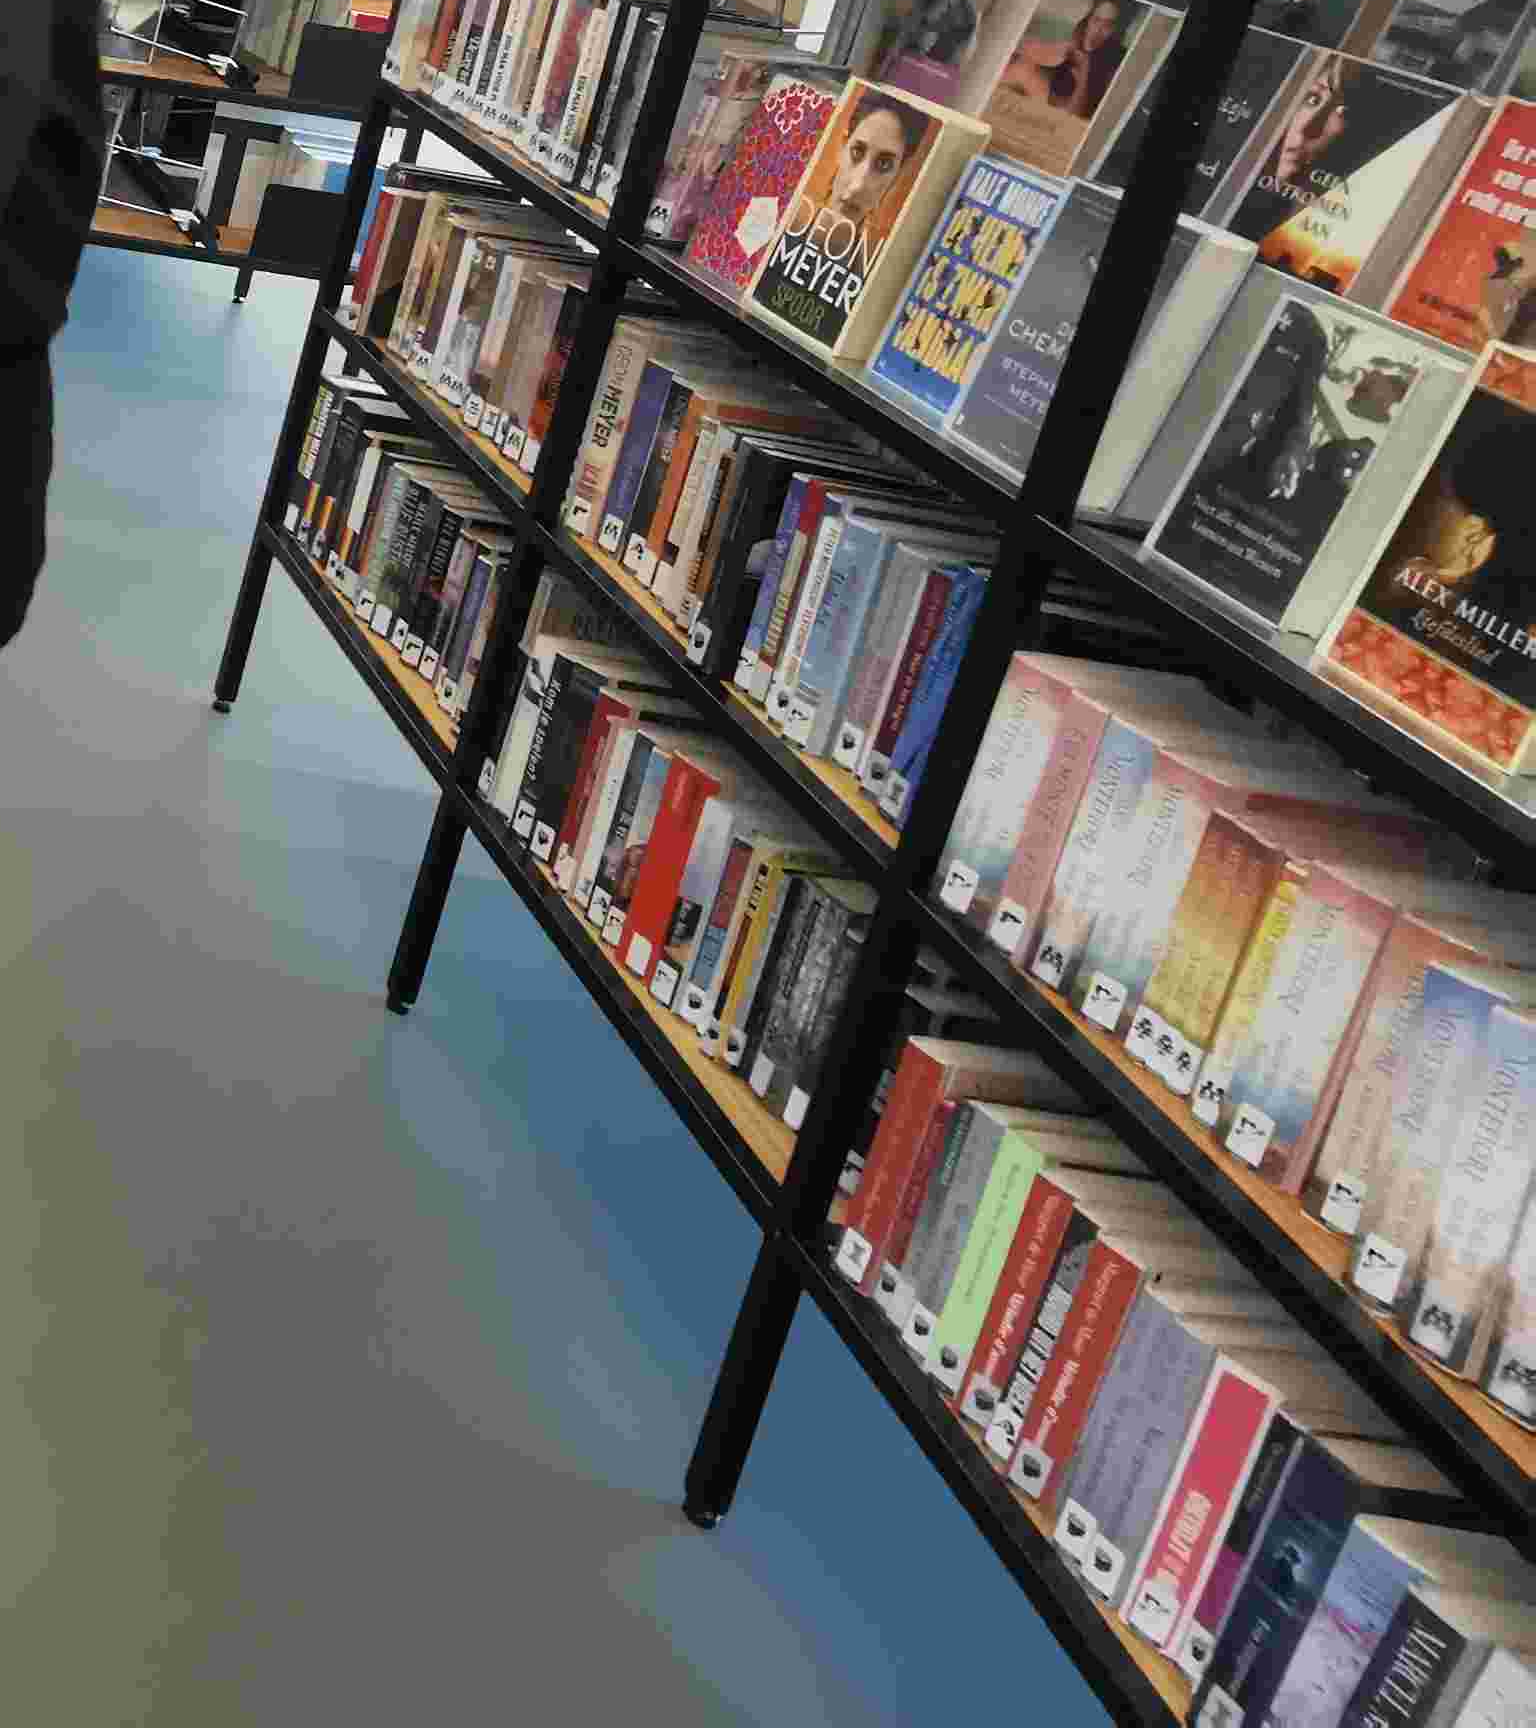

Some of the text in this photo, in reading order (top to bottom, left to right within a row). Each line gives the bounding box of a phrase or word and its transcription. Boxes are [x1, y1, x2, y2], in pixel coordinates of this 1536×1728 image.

[784, 196, 888, 276] DEON
[769, 237, 866, 313] MEYER
[771, 283, 826, 330] SPOOR
[591, 386, 626, 449] MEYER
[1391, 566, 1536, 661] ALEX MILLER
[542, 676, 564, 709] Kom
[522, 725, 549, 782] spelen?
